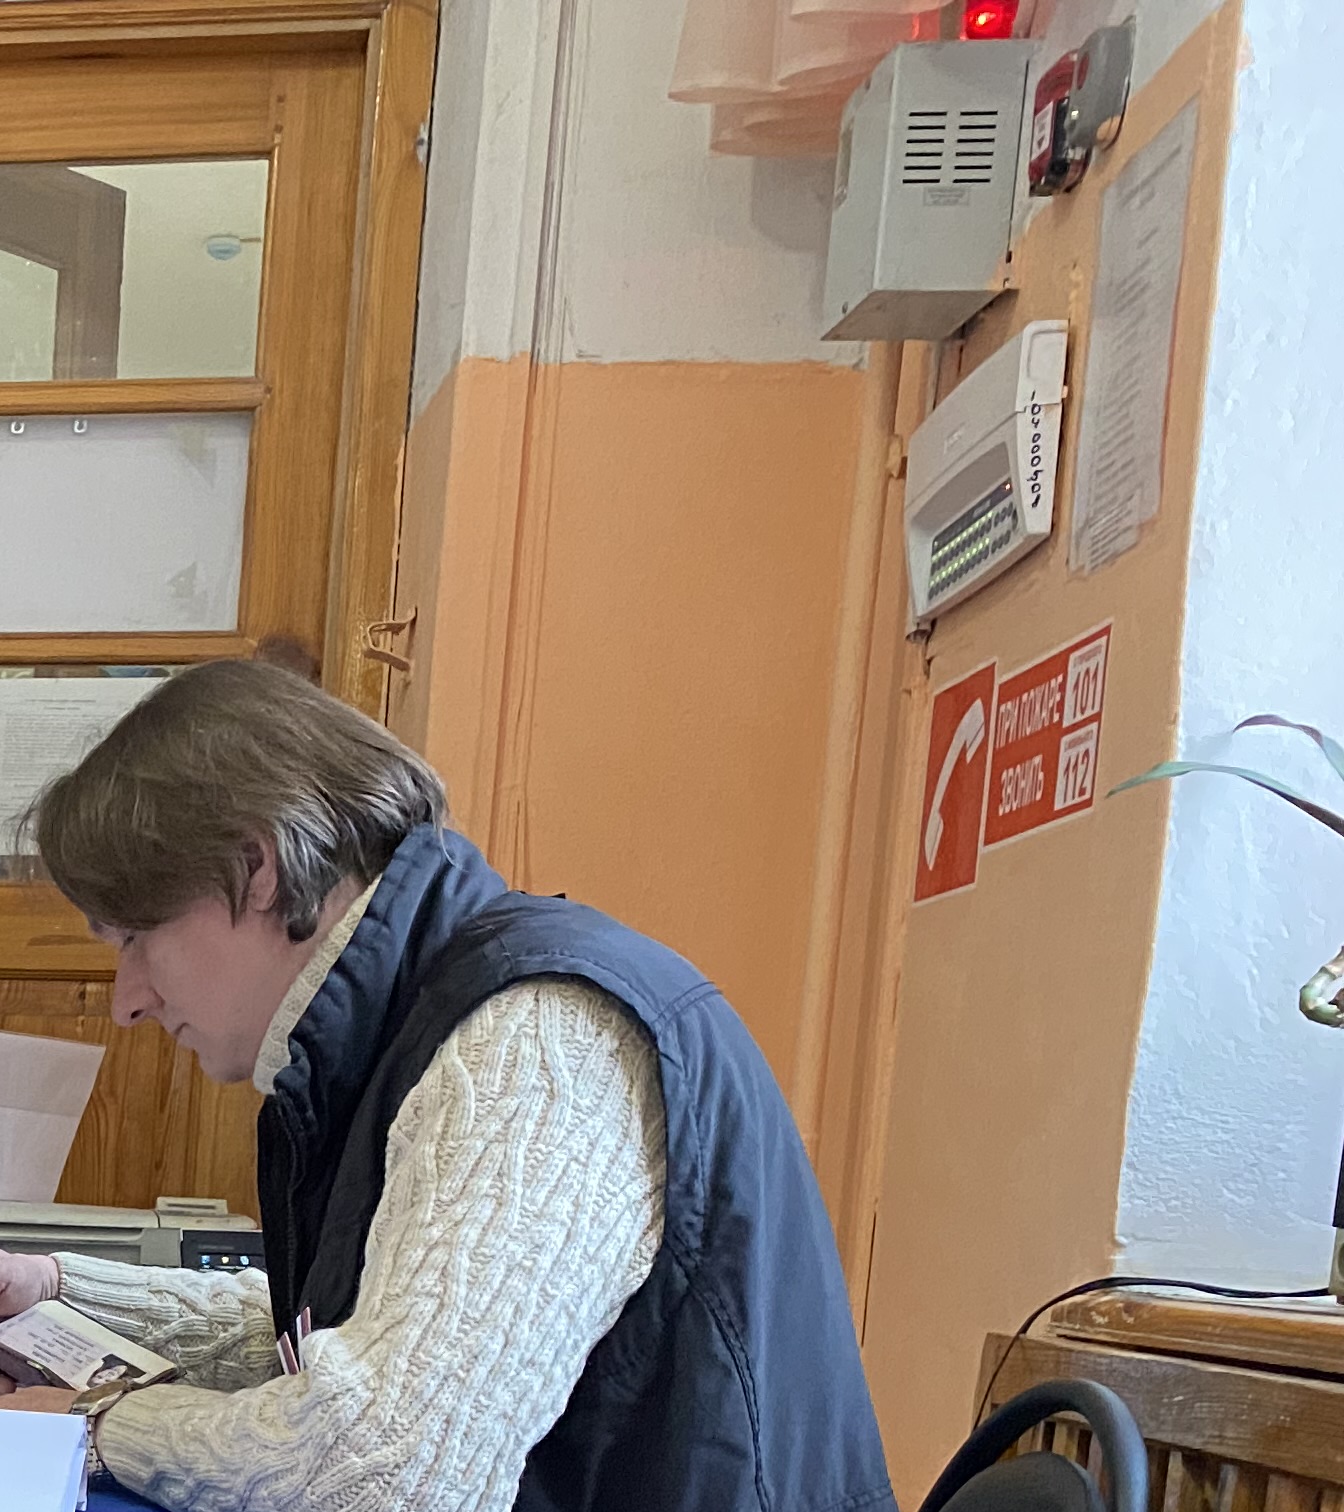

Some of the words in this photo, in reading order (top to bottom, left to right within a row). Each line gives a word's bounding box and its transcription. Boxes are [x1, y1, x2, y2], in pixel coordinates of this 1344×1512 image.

[995, 696, 1020, 748] ПРИ
[1018, 673, 1064, 740] ПОЖАРЕ
[1073, 661, 1099, 719] 101
[998, 754, 1044, 816] ЗВОНИТЬ
[1063, 748, 1090, 804] 112
